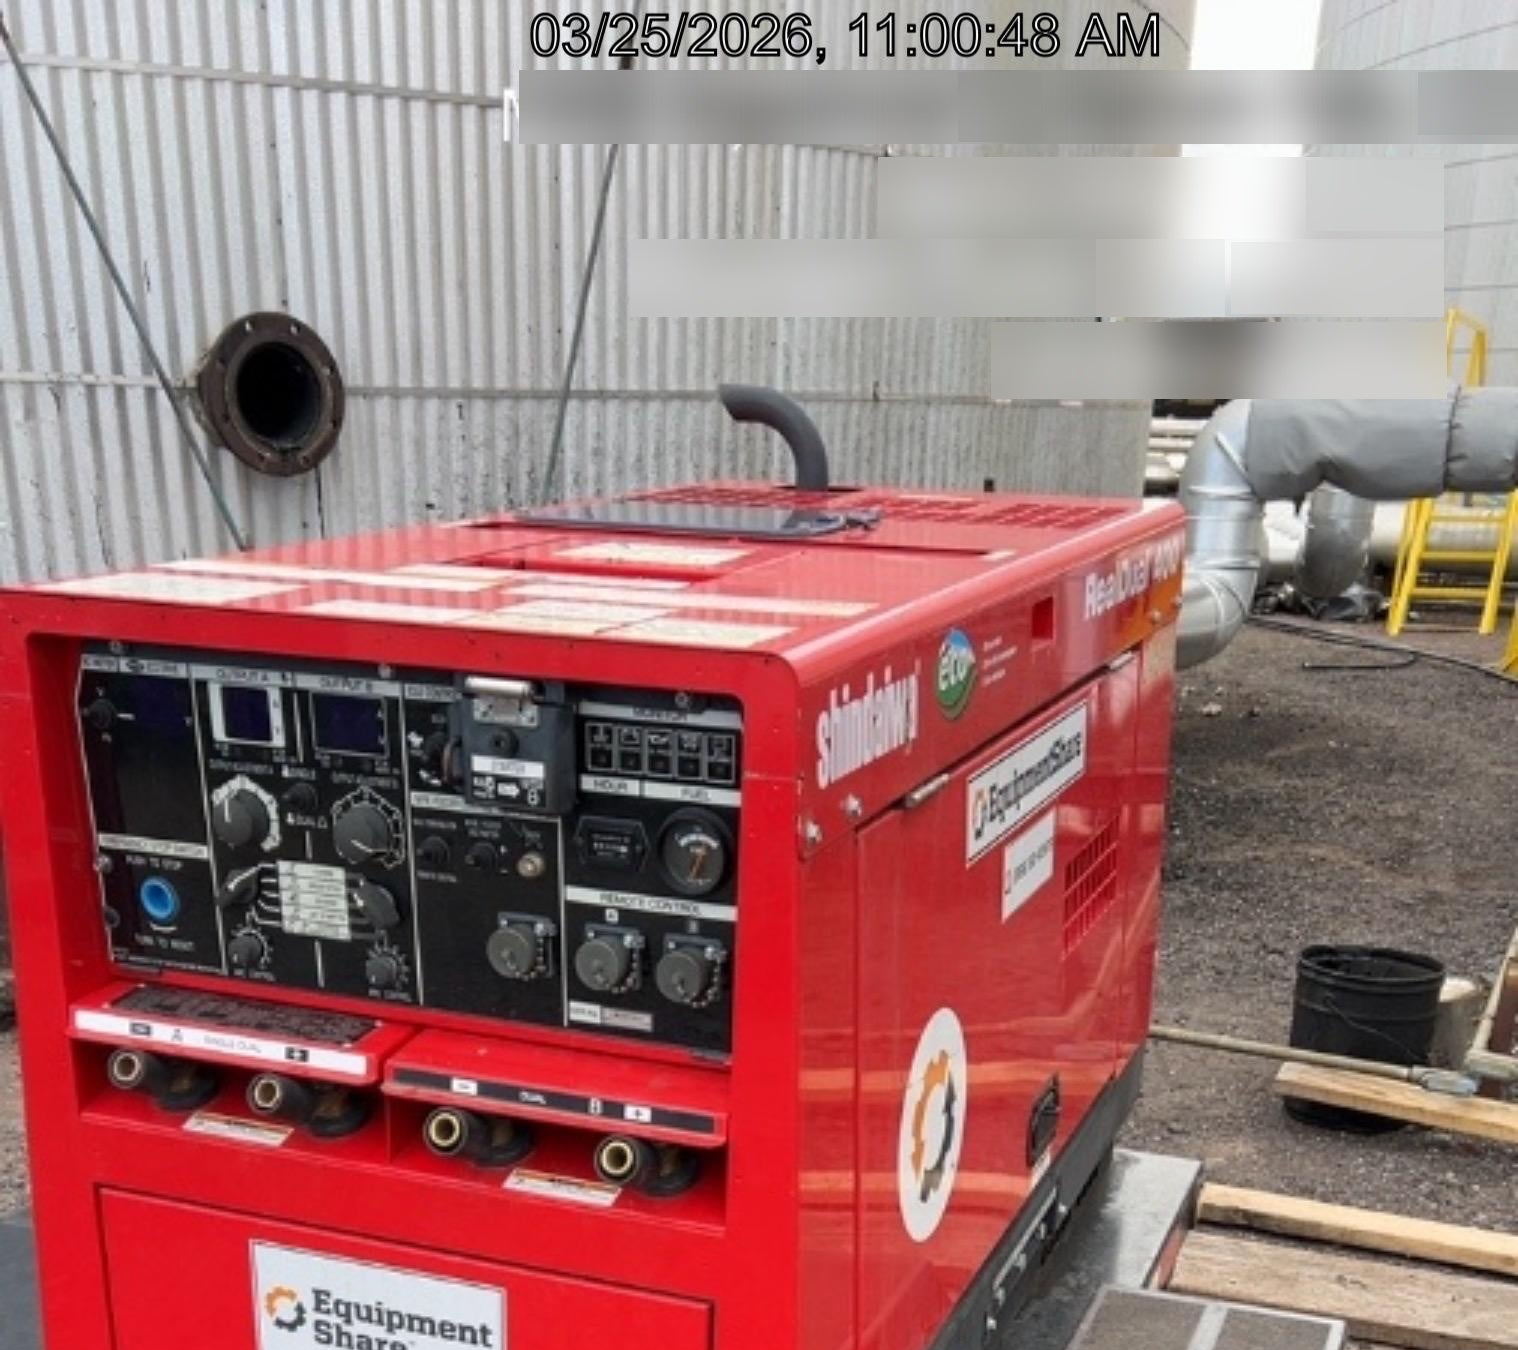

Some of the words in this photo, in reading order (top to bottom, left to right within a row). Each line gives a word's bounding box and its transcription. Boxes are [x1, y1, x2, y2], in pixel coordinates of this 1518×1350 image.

[593, 779, 628, 791] HOUR
[990, 733, 1081, 822] EquipmentShare
[600, 893, 645, 908] REMOTE
[312, 1286, 493, 1348] Equipment
